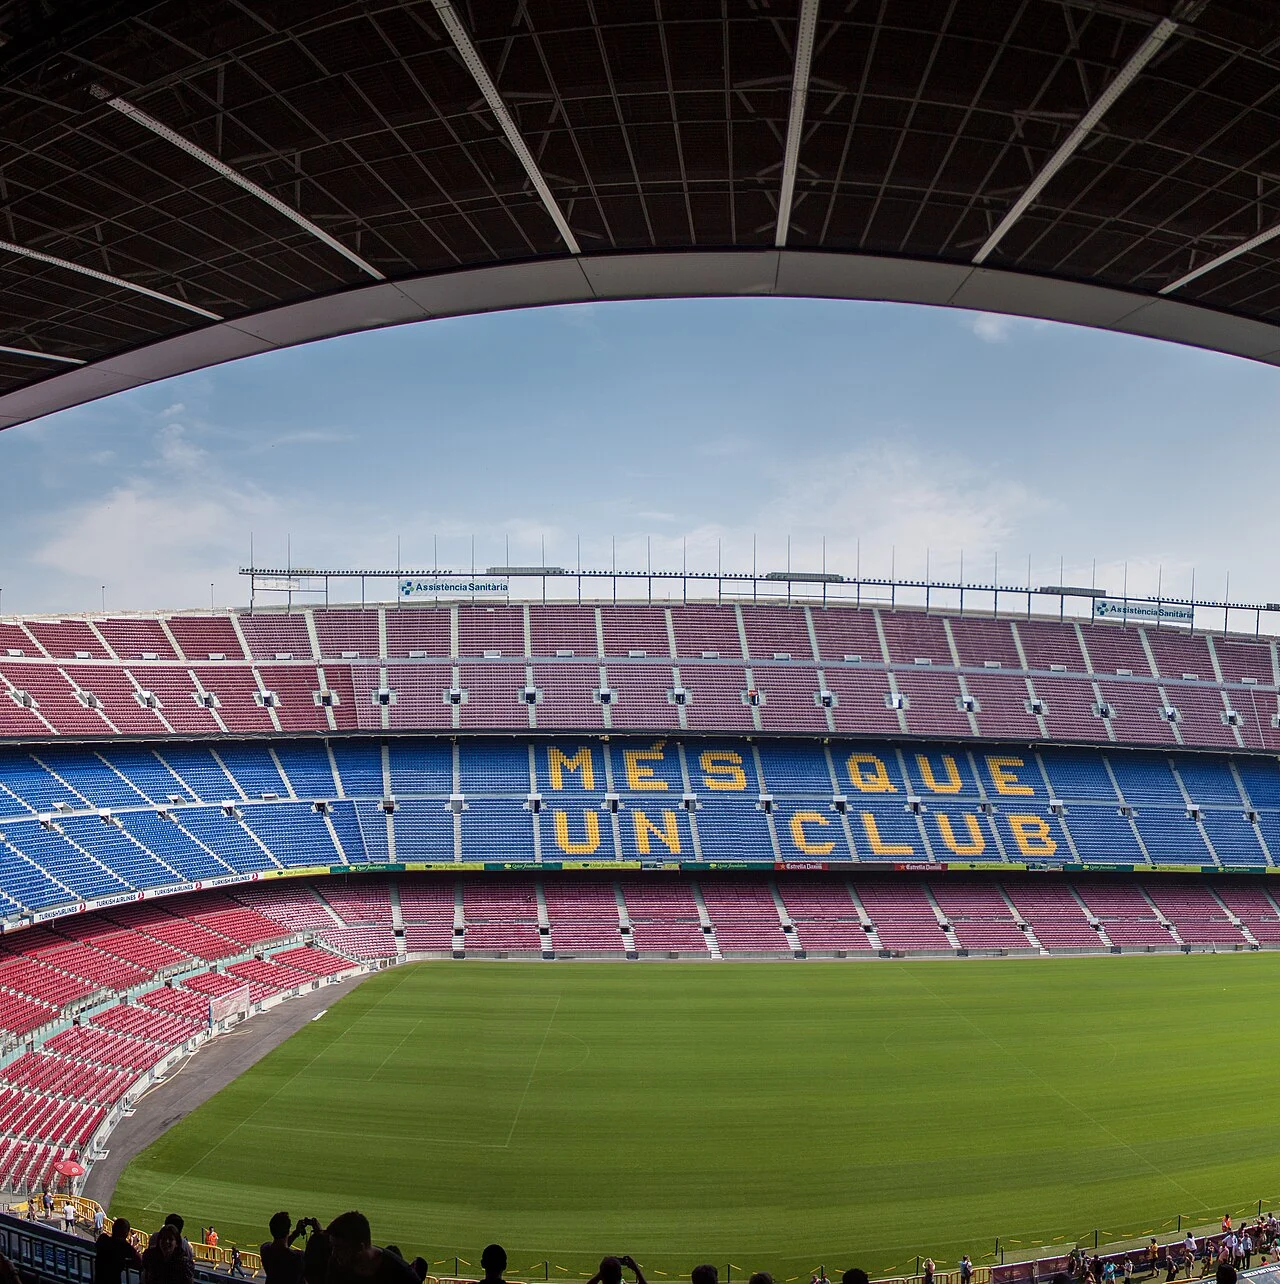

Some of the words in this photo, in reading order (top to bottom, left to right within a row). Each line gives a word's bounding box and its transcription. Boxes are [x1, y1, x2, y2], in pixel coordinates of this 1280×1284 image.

[415, 582, 467, 591] Assistència
[468, 582, 508, 591] Sanitària
[547, 740, 746, 791] MÉS
[845, 752, 1034, 796] QUE
[554, 810, 682, 854] UN
[789, 811, 1058, 856] CLUB
[212, 878, 230, 886] TURKISH
[231, 874, 250, 883] AIRLINES
[154, 887, 173, 896] TURKISH
[174, 884, 193, 892] AIRLINES
